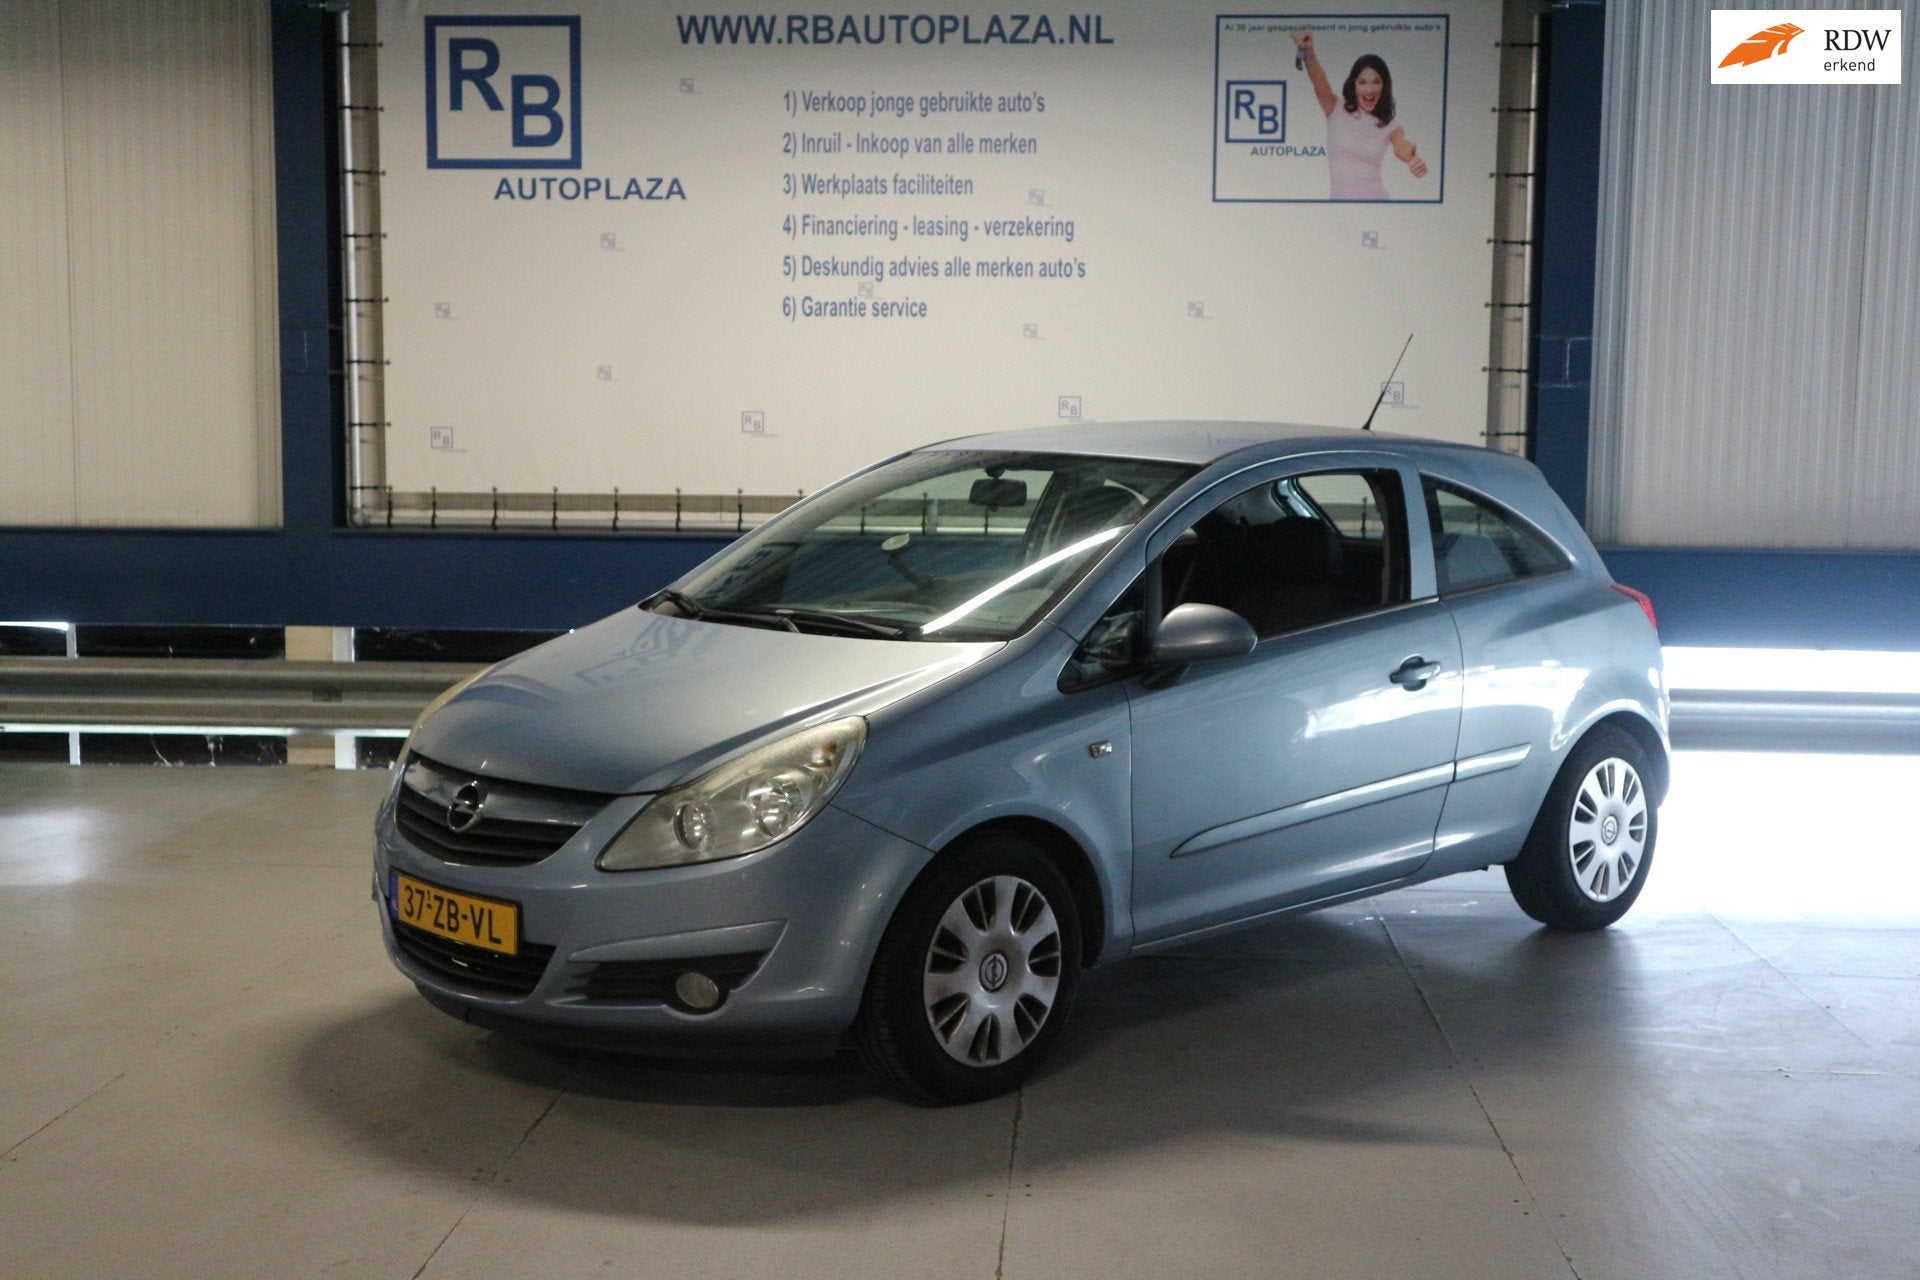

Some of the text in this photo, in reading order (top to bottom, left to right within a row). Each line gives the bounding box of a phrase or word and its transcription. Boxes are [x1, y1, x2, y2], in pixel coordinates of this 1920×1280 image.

[676, 14, 1115, 45] WWW.RBAUTOPLAZA.NL
[1370, 23, 1411, 33] gebruikte
[783, 91, 1045, 117] 1) Verkoop jonge gebruikte auto's
[783, 133, 797, 158] 2)
[802, 133, 841, 154] Inruil
[856, 133, 909, 158] Inkoop
[914, 138, 942, 154] van
[947, 133, 974, 154] alle
[979, 133, 1037, 154] merken
[1250, 146, 1326, 157] AUTOPLAZA
[494, 177, 686, 200] AUTOPLAZA
[782, 173, 973, 199] 3) Werkplaats faciliteiten
[782, 214, 797, 240] 4)
[801, 214, 898, 241] Financiering
[913, 215, 969, 241] leasing
[984, 215, 1074, 242] verzekering
[782, 255, 1086, 281] 5) Deskundig advies alle merken auto's
[782, 296, 927, 321] 6) Garantie service
